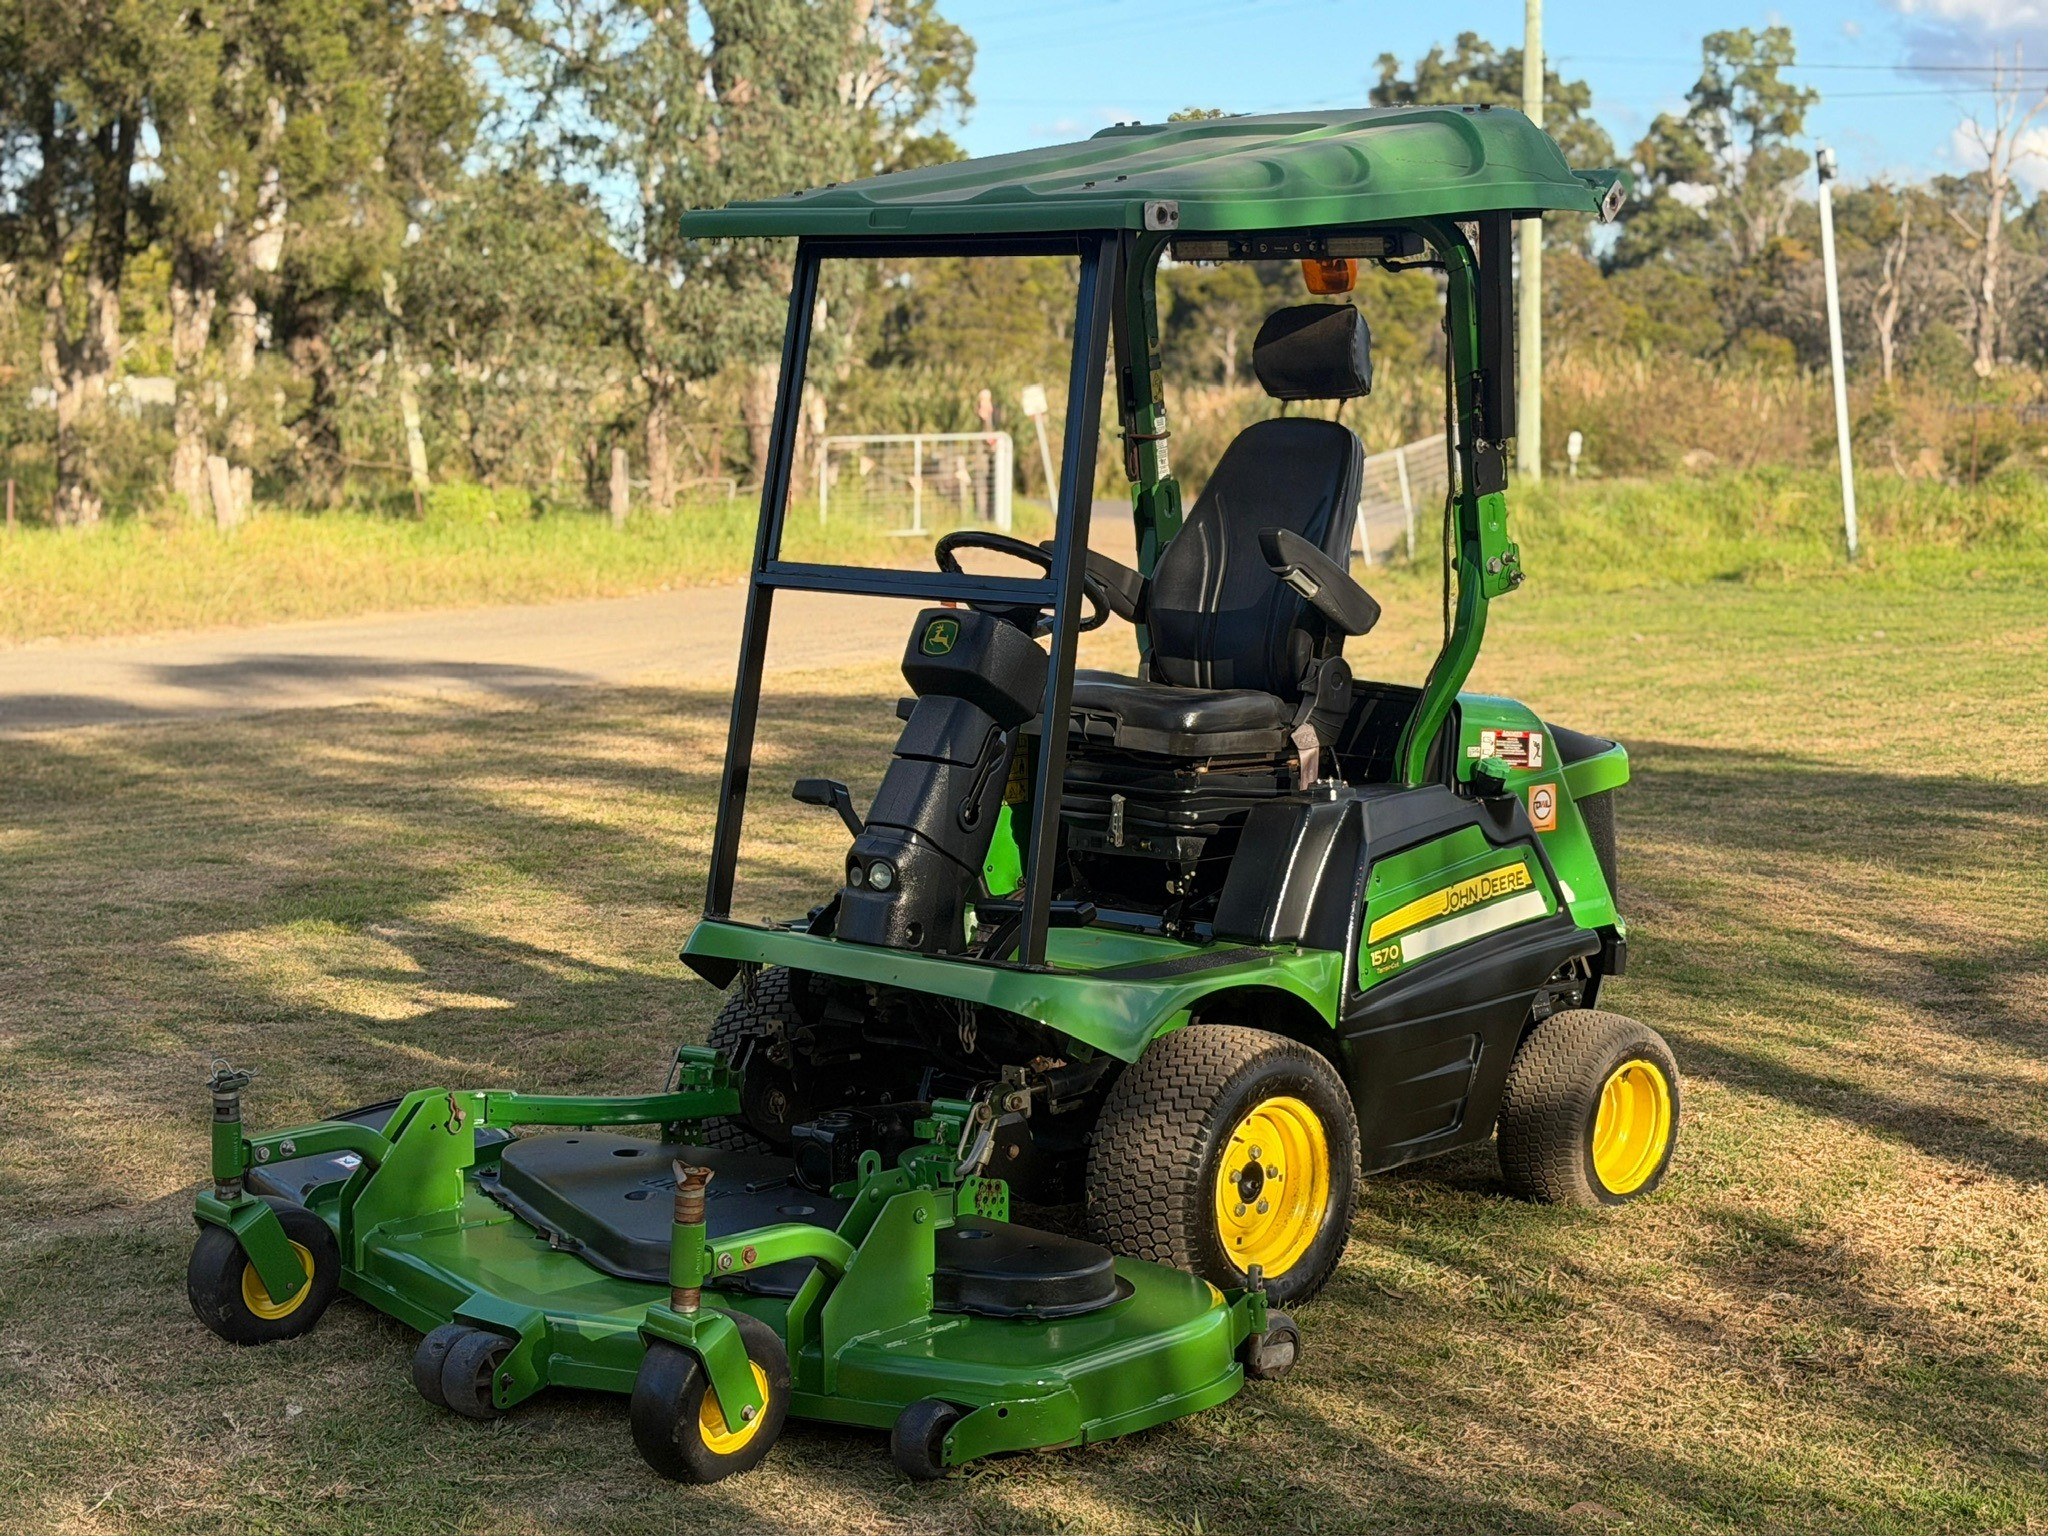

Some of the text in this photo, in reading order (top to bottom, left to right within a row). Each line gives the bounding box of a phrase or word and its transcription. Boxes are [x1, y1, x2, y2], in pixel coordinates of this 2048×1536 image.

[1442, 869, 1525, 913] JOHN DEERE
[1370, 945, 1400, 967] 1570
